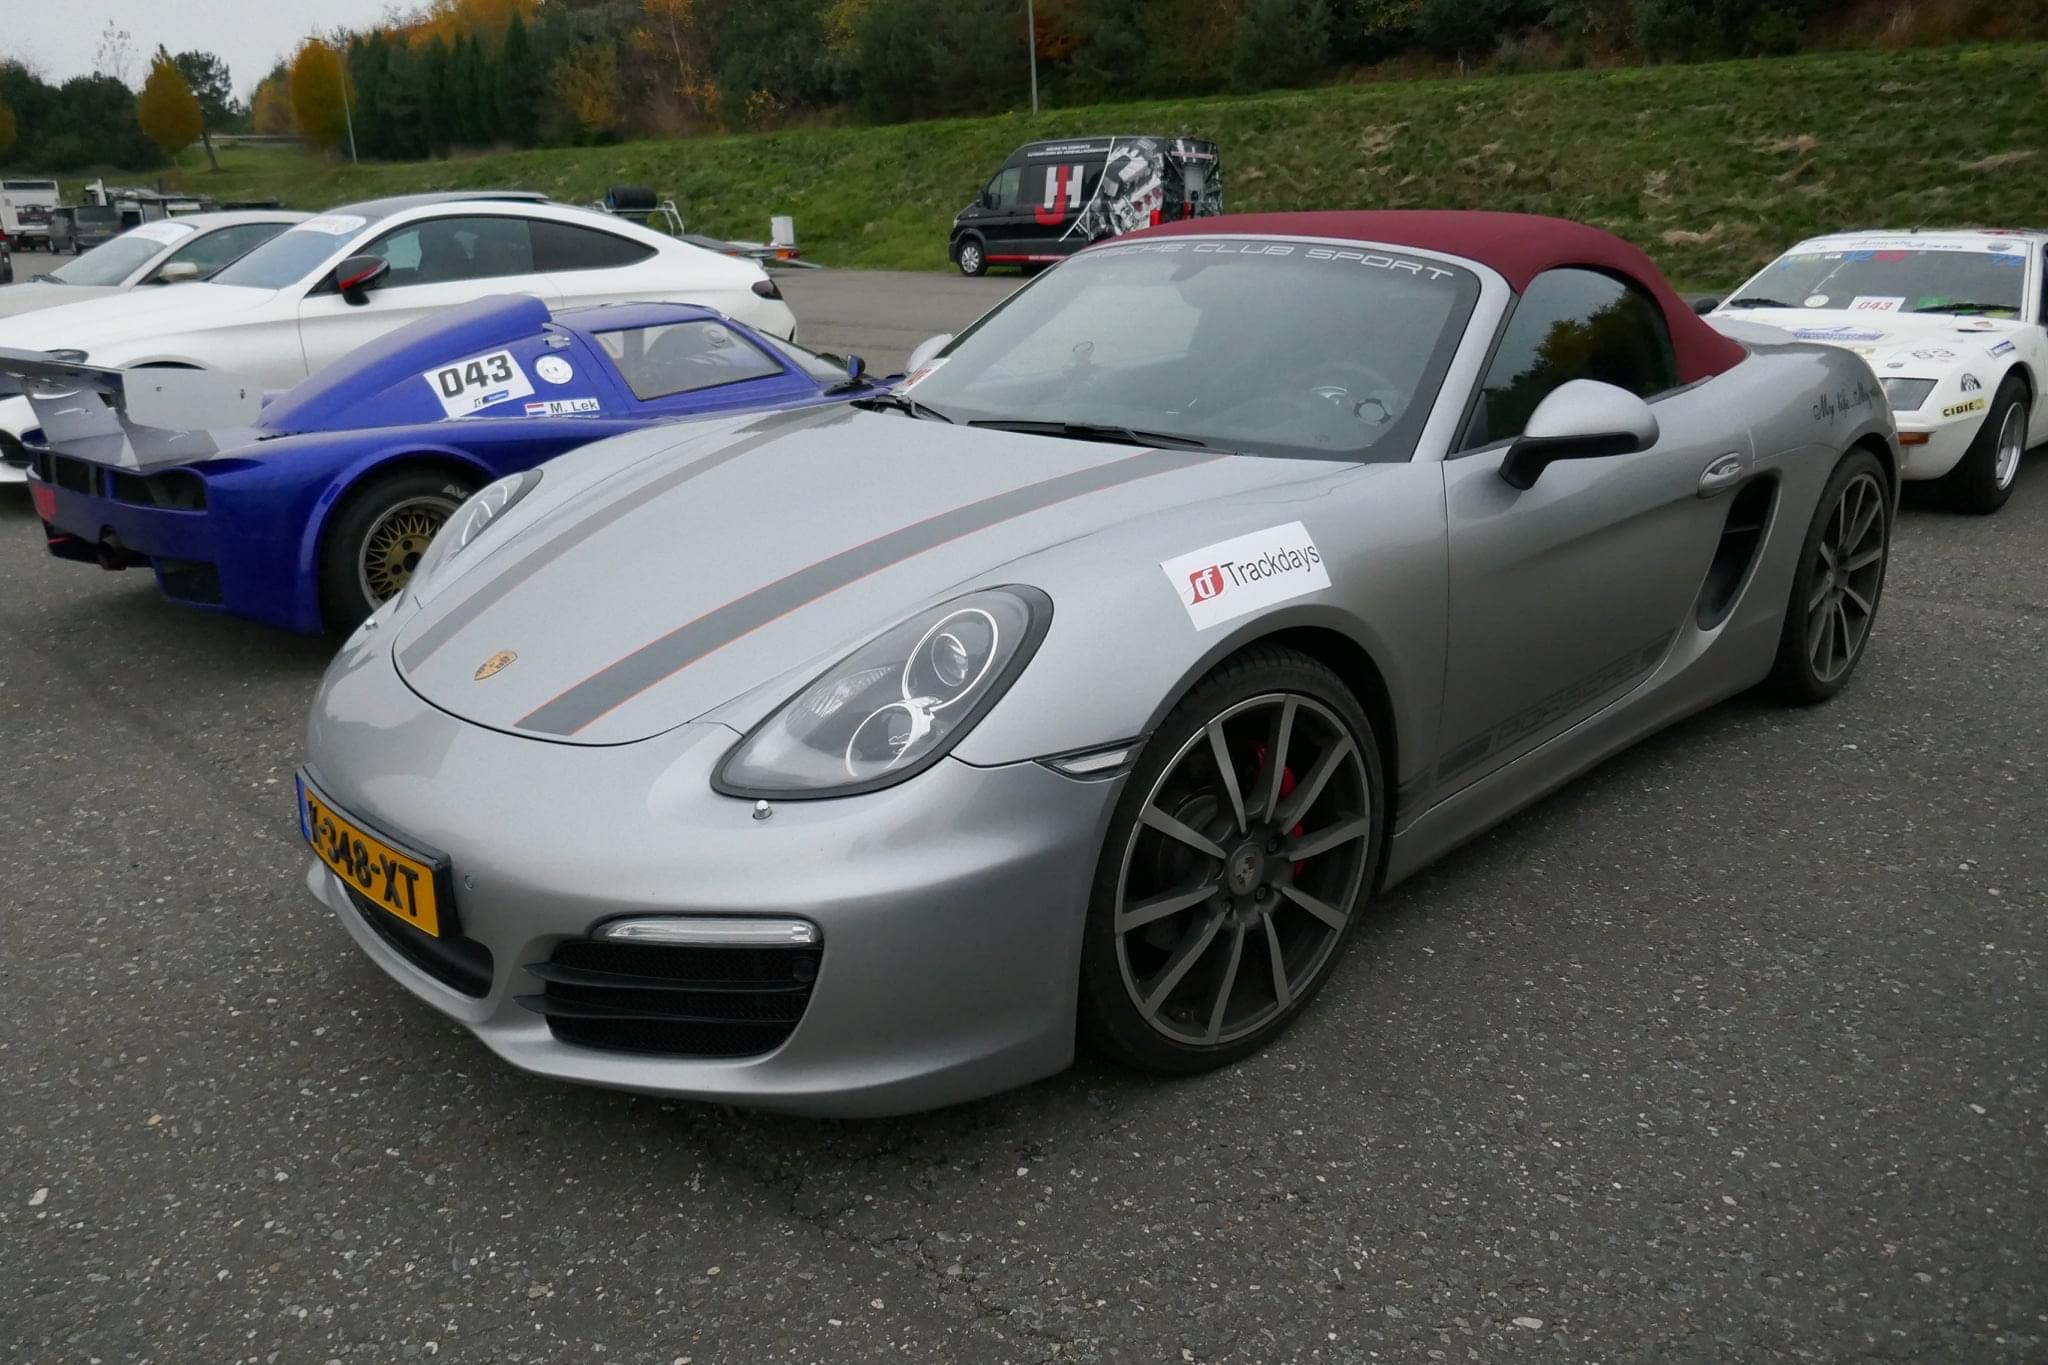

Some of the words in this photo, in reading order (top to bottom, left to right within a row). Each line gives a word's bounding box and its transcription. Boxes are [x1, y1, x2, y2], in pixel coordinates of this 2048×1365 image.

[1192, 243, 1294, 256] CLUB
[1305, 248, 1454, 280] SPORT
[1856, 301, 1894, 310] 043
[438, 354, 513, 399] 043
[550, 402, 568, 414] M.
[571, 399, 598, 412] Lek
[1942, 401, 1976, 417] CIBIE
[1220, 545, 1321, 587] Trackdays
